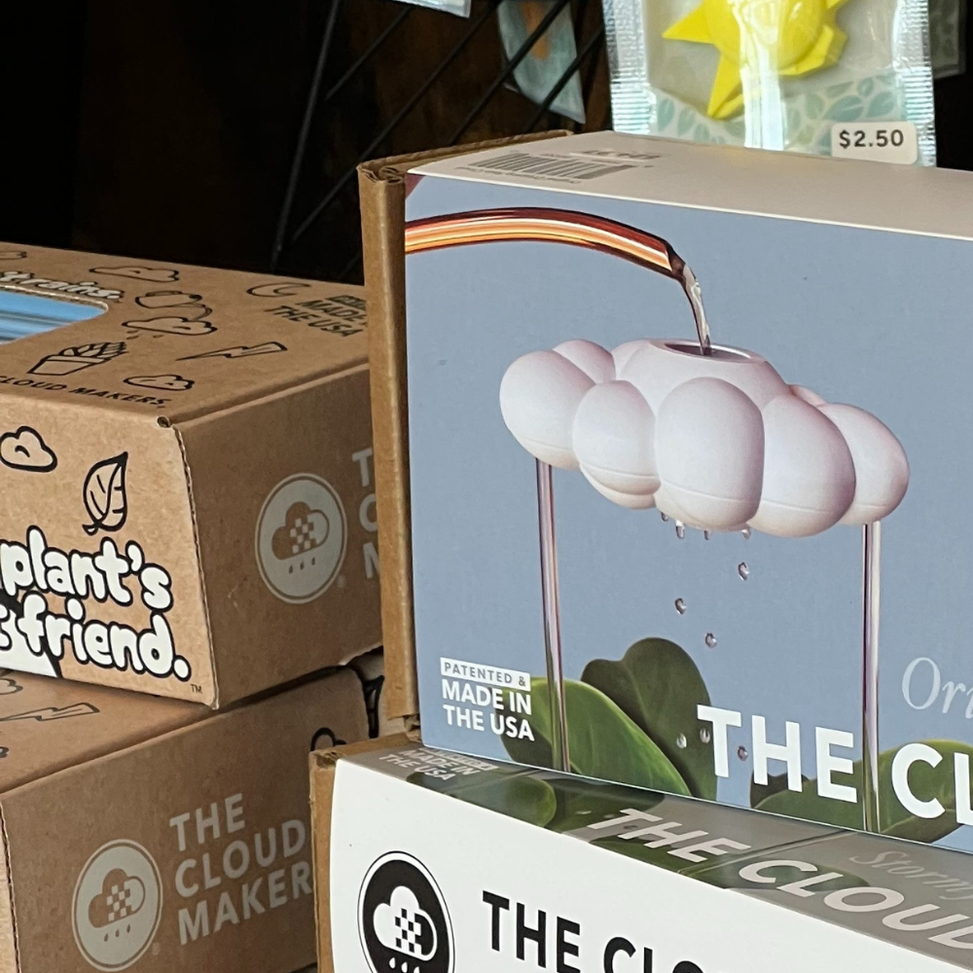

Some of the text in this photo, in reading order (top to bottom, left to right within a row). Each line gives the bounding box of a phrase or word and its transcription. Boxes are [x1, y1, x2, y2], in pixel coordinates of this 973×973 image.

[838, 128, 905, 149] $2.50
[69, 387, 172, 405] MAKERS
[0, 527, 171, 610] plant's
[16, 592, 191, 681] friend.
[442, 679, 532, 715] MADE IN
[444, 662, 527, 687] PATENTED &
[443, 704, 535, 741] THE USA
[379, 754, 420, 768] THE
[414, 765, 456, 780] USA
[697, 704, 858, 803] THE
[169, 793, 246, 852] THE
[587, 808, 751, 863] THE
[174, 819, 306, 888] CLOUD
[178, 861, 313, 946] MAKER
